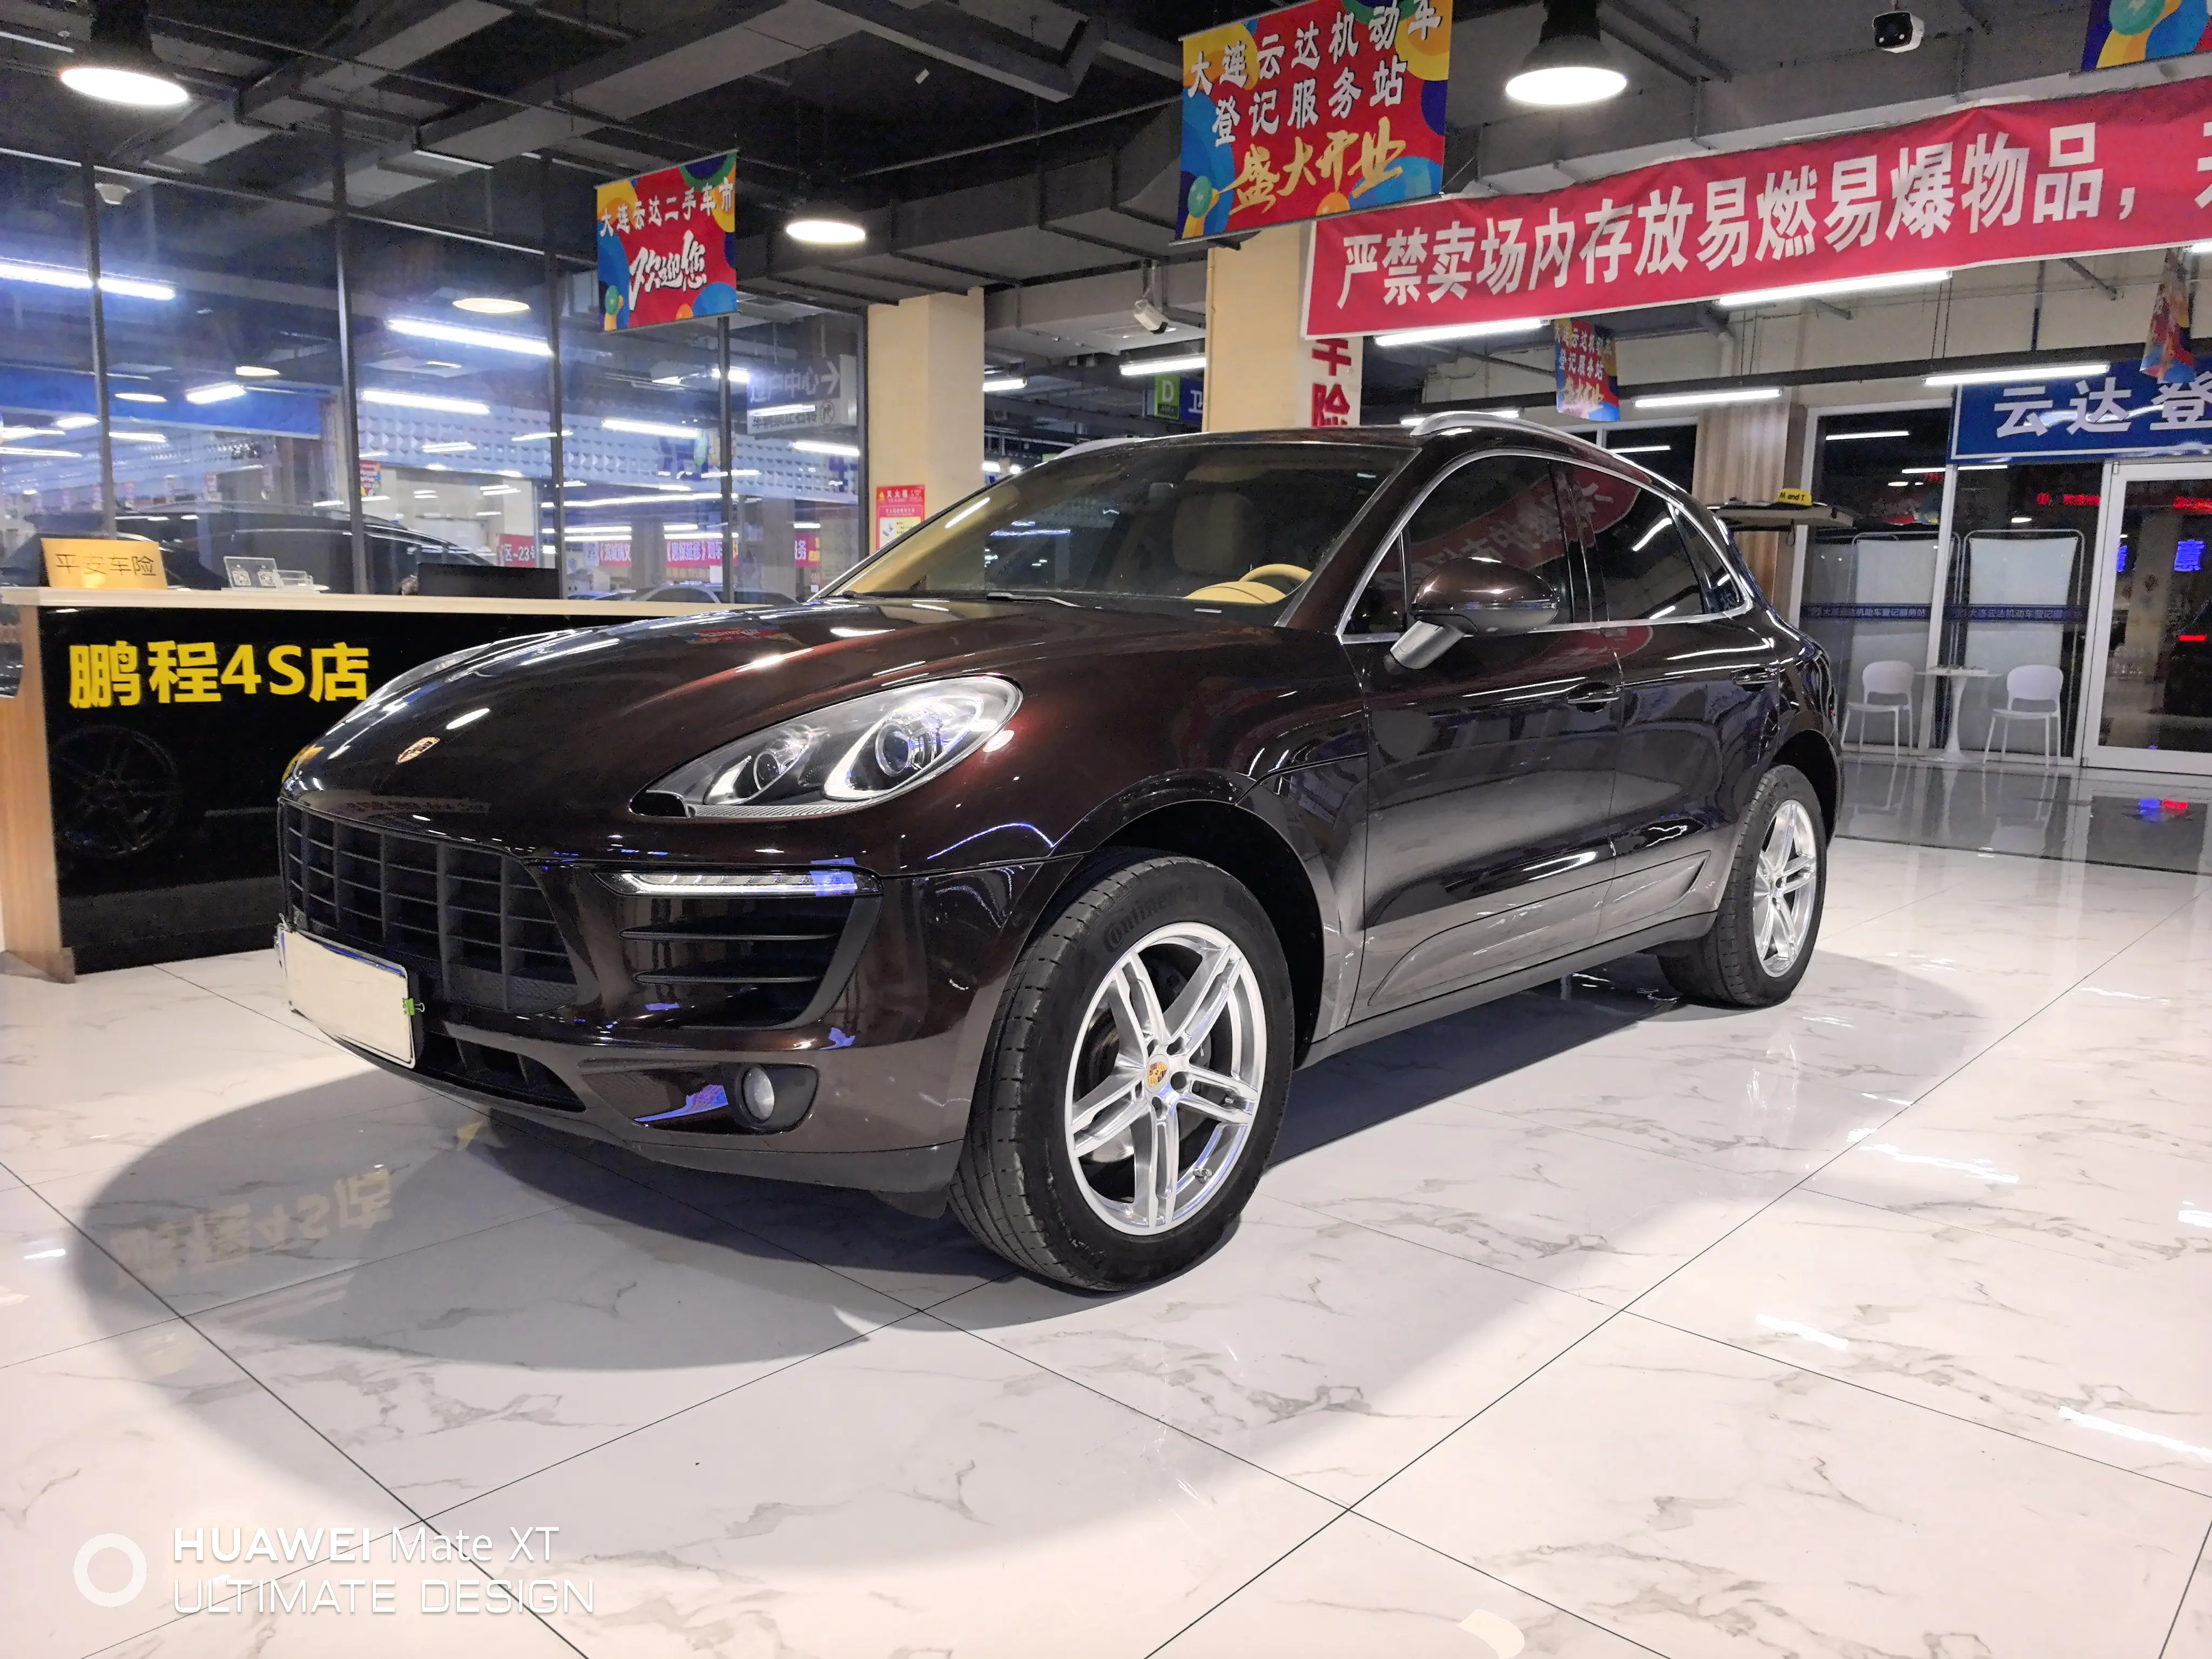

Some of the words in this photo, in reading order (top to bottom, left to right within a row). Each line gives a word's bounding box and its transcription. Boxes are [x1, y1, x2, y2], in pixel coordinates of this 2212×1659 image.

[1189, 0, 1442, 98] 大连云达机动车
[1212, 55, 1407, 147] 登记服务站
[1219, 116, 1406, 215] 盛大开业
[600, 177, 734, 237] 大连云达二手车市
[629, 230, 707, 311] 欢迎您
[1162, 380, 1175, 402] D
[1994, 371, 2212, 438] 云达登
[1787, 493, 1799, 501] and
[56, 554, 157, 576] 平安车险
[69, 640, 369, 709] 鹏程4S店
[1103, 885, 1204, 953] Continen
